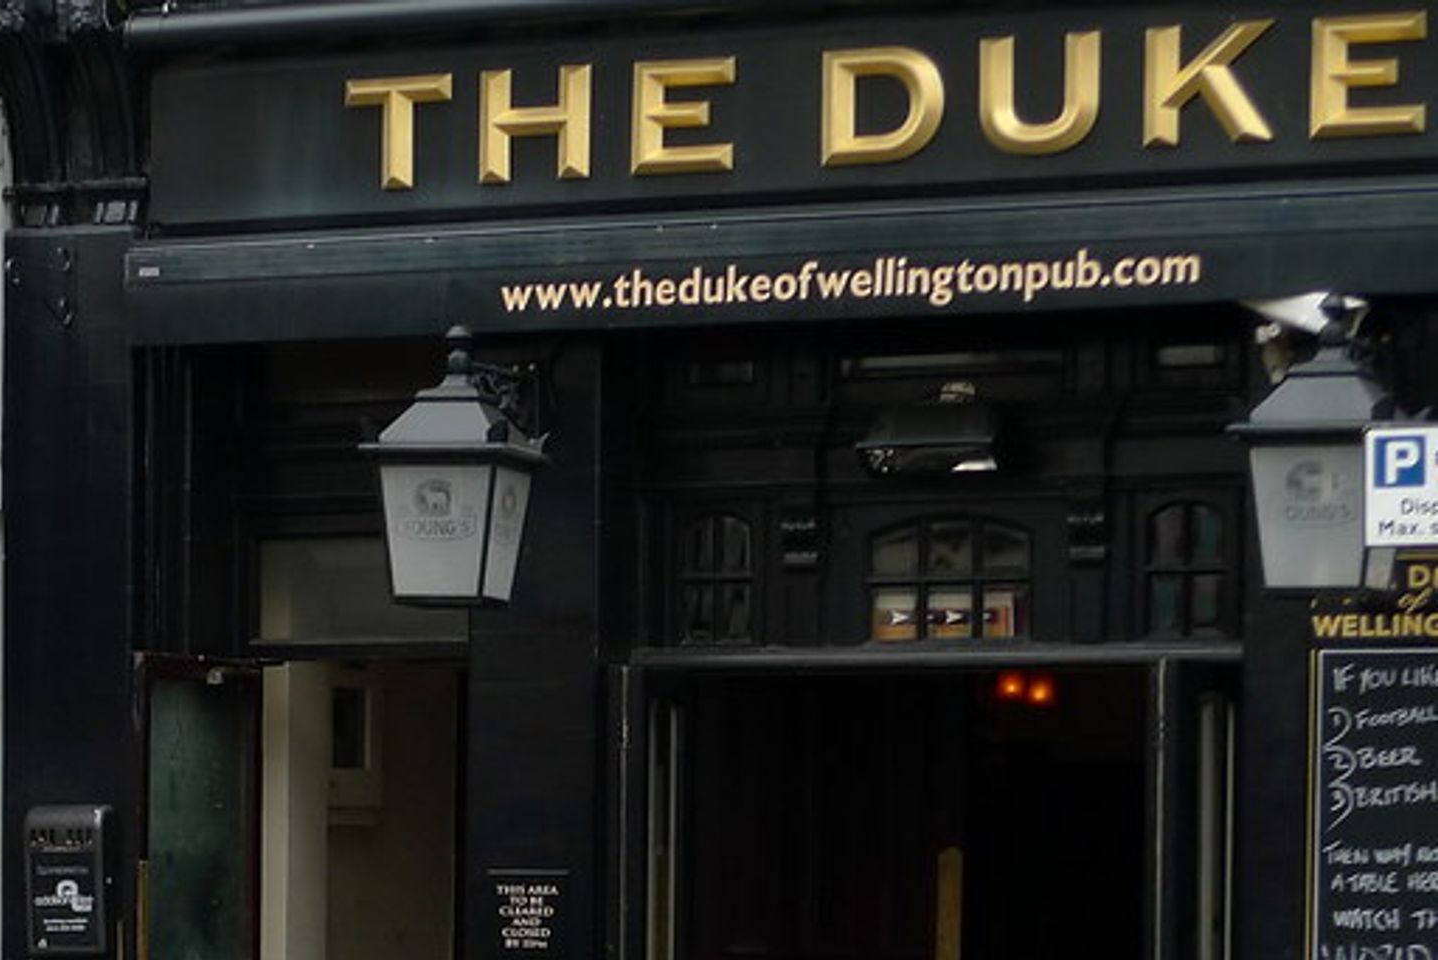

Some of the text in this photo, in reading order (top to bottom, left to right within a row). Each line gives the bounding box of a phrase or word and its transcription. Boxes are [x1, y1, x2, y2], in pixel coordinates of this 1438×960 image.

[344, 11, 1428, 190] THE DUKE
[501, 249, 1201, 312] www.thedukeofwellingtonpub.com
[1384, 440, 1420, 485] P
[1408, 563, 1438, 589] D
[1359, 667, 1397, 695] YOU
[1401, 663, 1438, 688] LIK
[1356, 746, 1423, 769] BEER
[1333, 907, 1400, 931] WATCH
